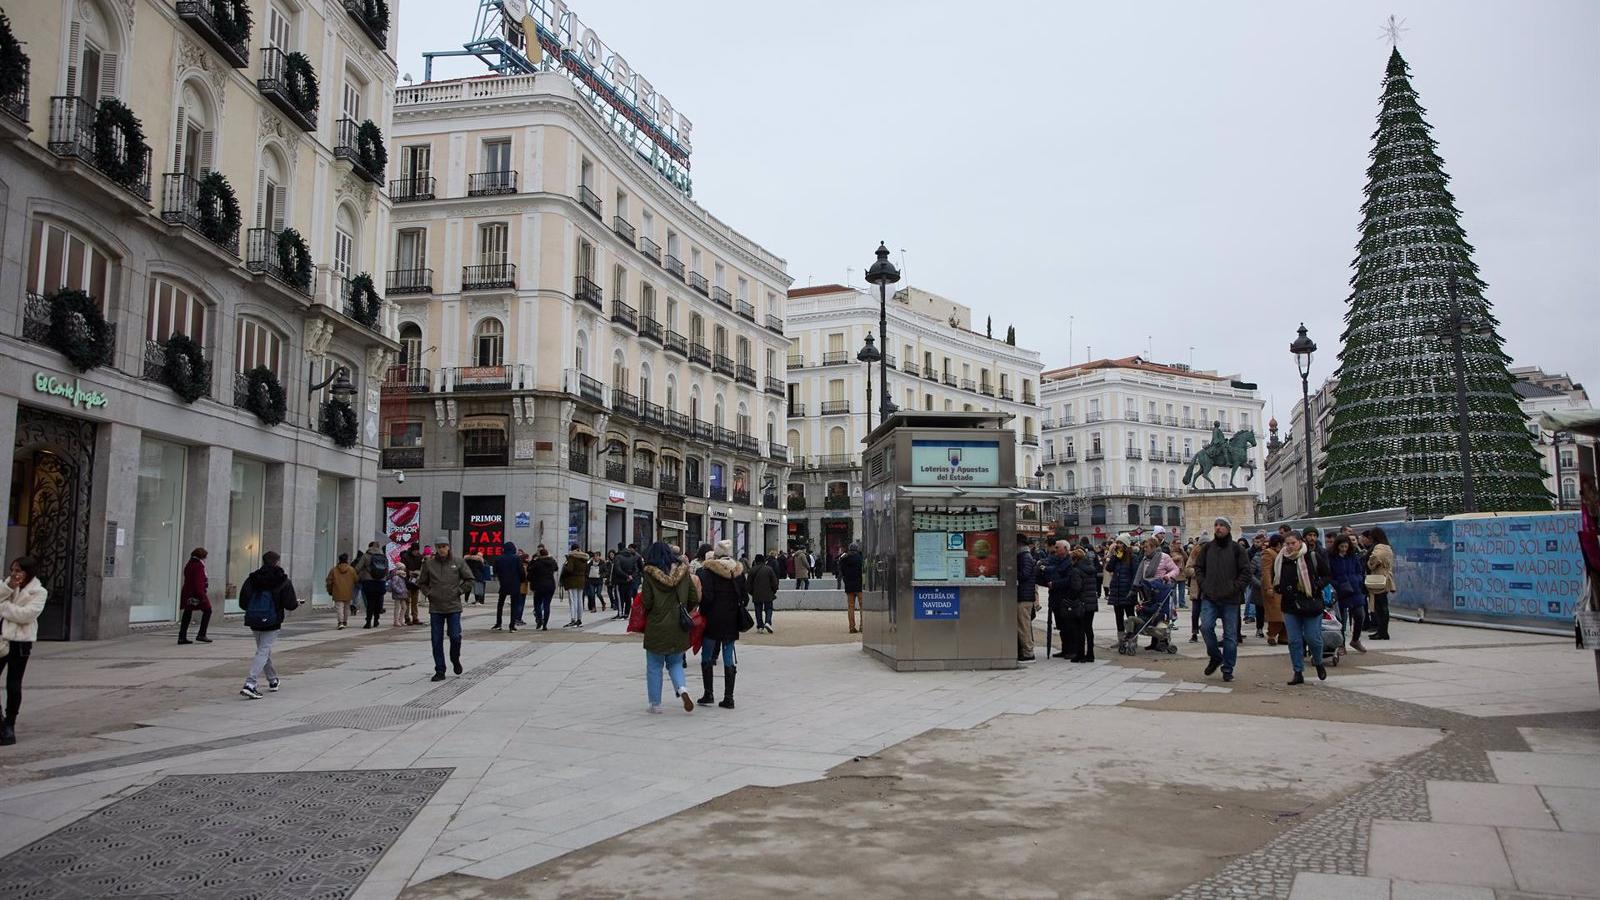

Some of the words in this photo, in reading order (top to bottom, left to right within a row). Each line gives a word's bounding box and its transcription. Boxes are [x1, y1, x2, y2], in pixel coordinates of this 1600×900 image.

[613, 52, 692, 154] PEPE
[48, 377, 74, 399] Corte
[957, 466, 989, 474] Apuestas
[470, 531, 502, 543] TAX
[1486, 522, 1508, 537] SOL
[1465, 540, 1516, 555] MADRID
[1519, 540, 1543, 555] SOL
[1470, 559, 1491, 574] SOL
[1515, 559, 1572, 576] MADRID
[1488, 577, 1510, 593] SOL
[918, 592, 945, 600] LOTERÍA
[1466, 596, 1517, 612] MADRID
[1520, 598, 1544, 614] SOL
